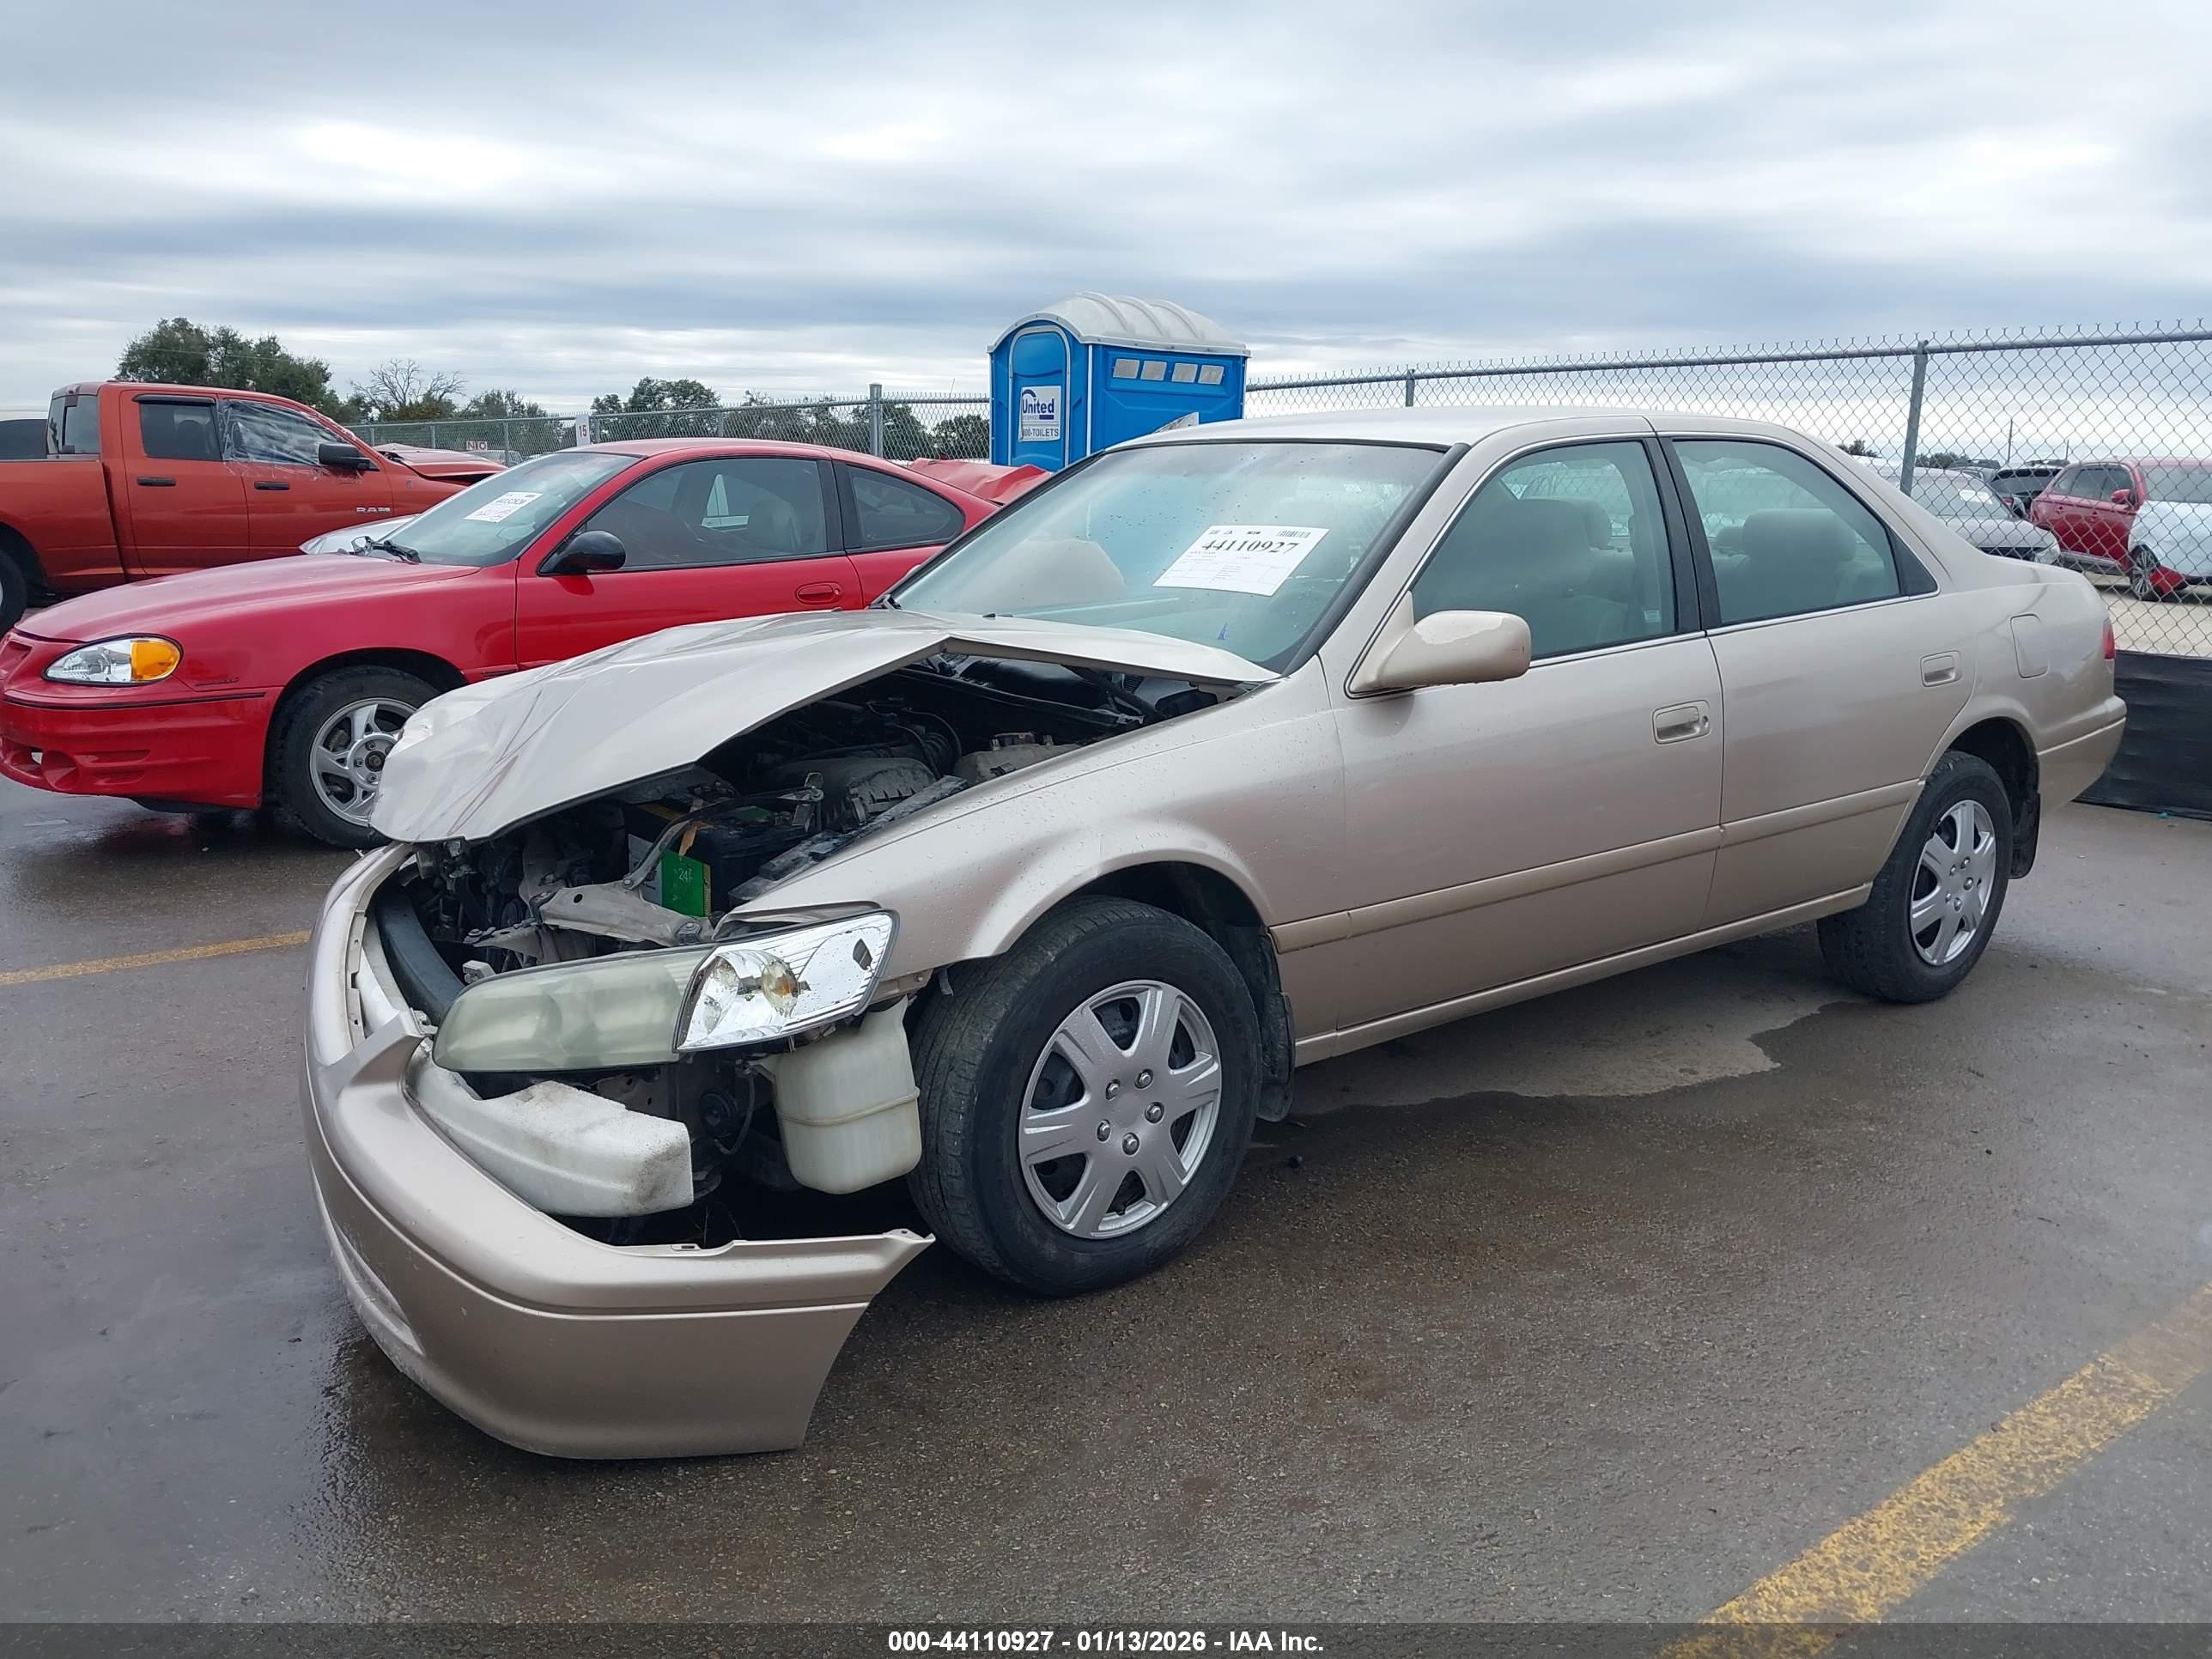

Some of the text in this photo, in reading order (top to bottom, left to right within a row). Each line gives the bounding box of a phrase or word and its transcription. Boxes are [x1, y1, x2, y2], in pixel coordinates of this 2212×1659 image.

[1022, 398, 1054, 414] United
[579, 425, 587, 437] 15
[1201, 539, 1300, 554] 44110927
